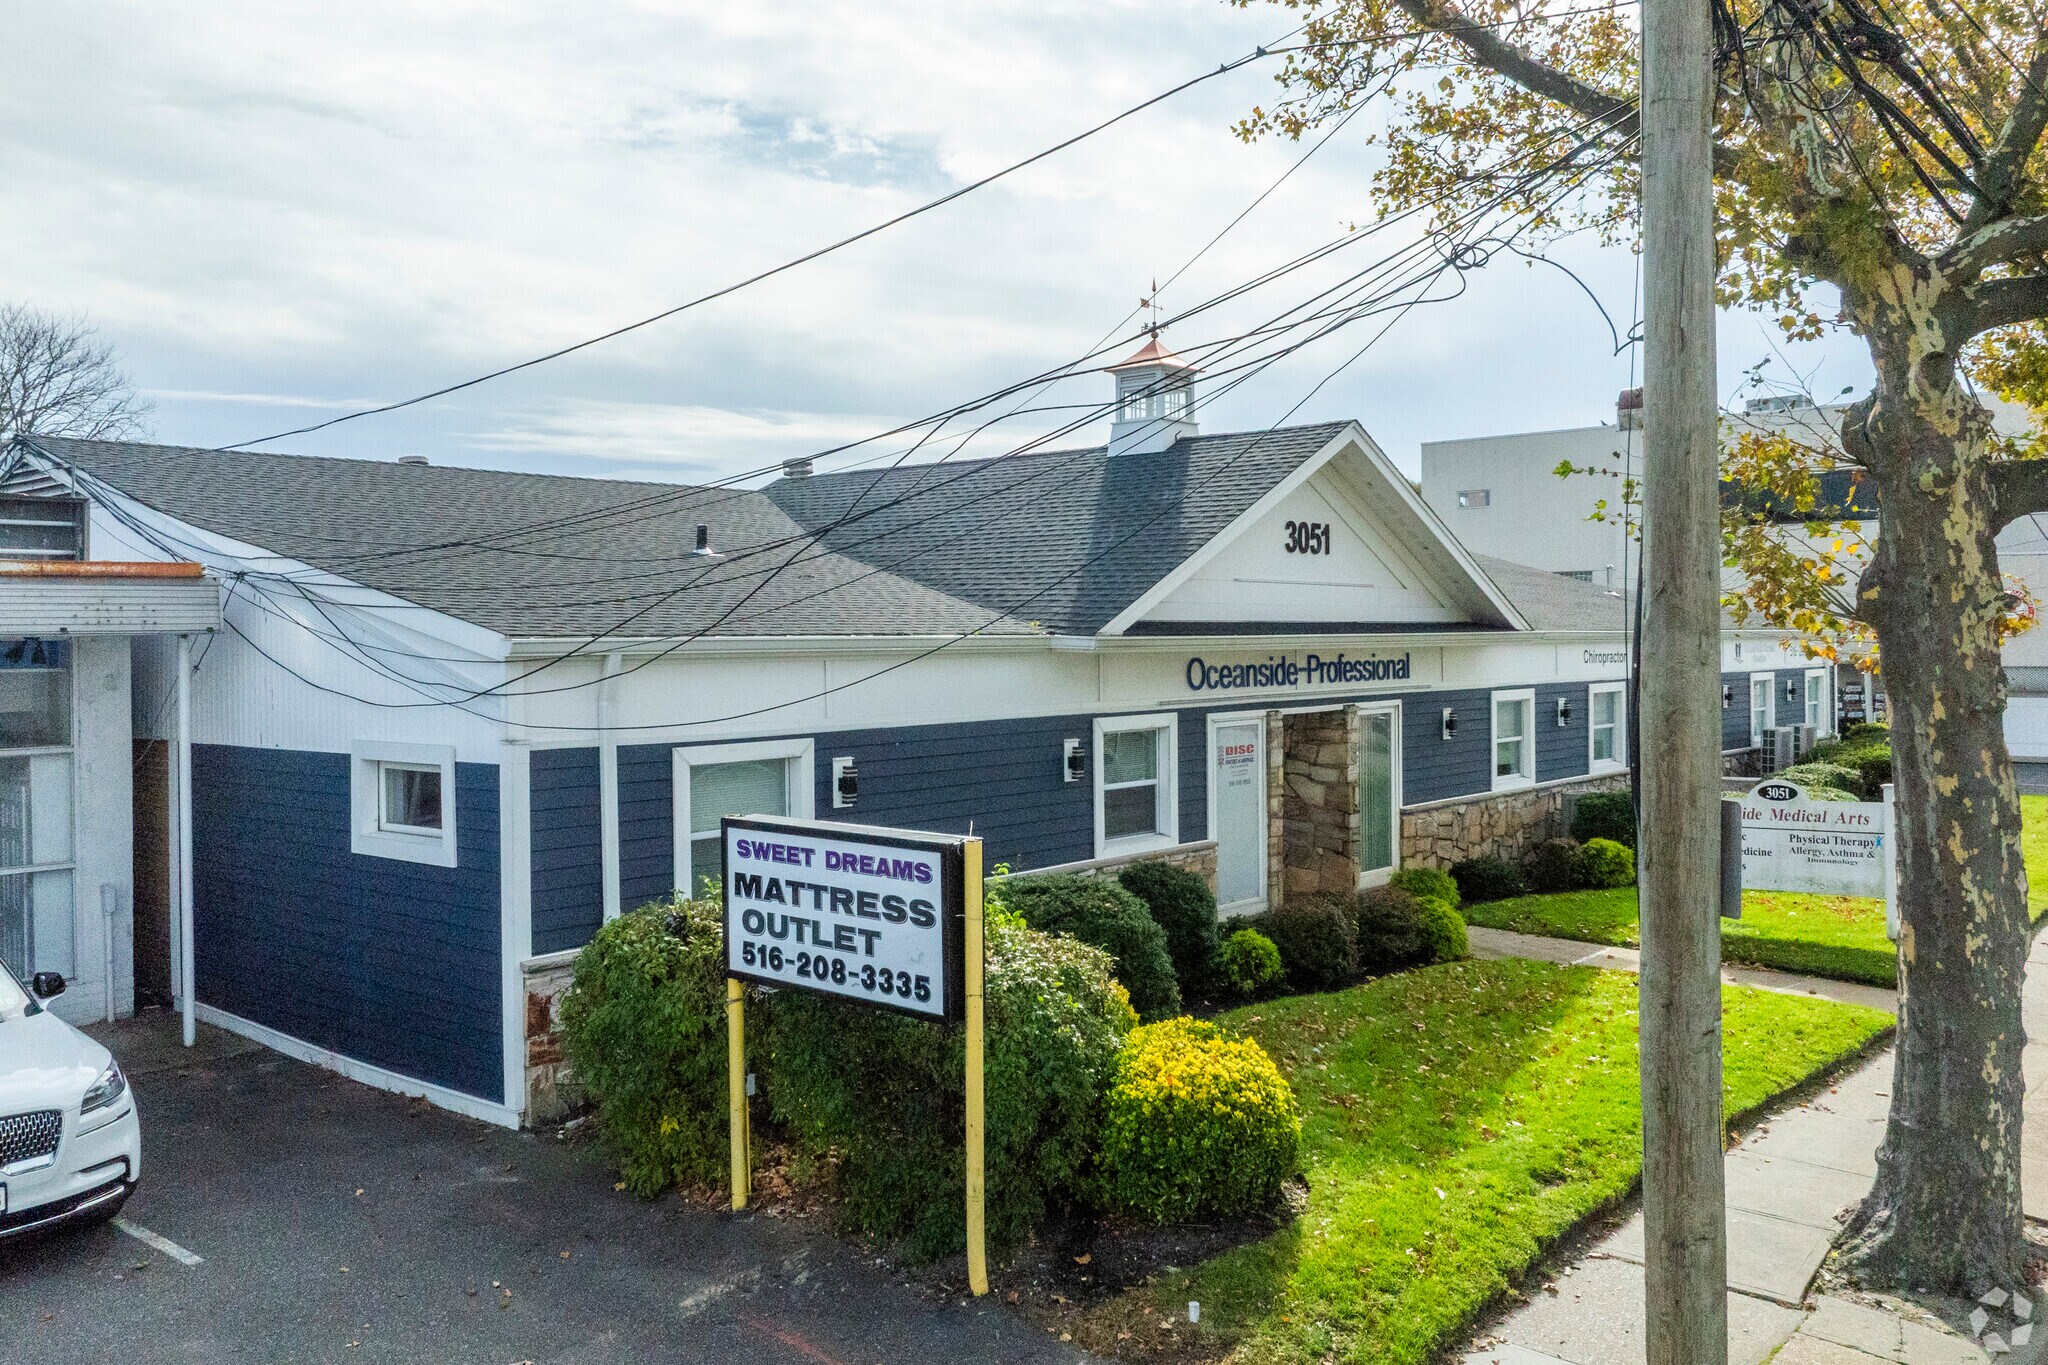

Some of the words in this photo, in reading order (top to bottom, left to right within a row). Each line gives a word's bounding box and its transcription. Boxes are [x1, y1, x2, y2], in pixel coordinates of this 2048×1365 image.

[1285, 520, 1331, 555] 3051
[1186, 652, 1411, 691] Oceanside-Professional
[1225, 744, 1254, 756] DISC
[1765, 787, 1790, 799] 3051
[1769, 808, 1828, 823] Medical
[1835, 812, 1870, 825] Arts
[1789, 833, 1830, 846] Physical
[1833, 836, 1876, 849] Therapy
[1789, 847, 1825, 858] Allergy,
[1827, 849, 1864, 858] Asthma
[1866, 850, 1876, 859] &
[736, 839, 815, 867] SWEET
[825, 850, 933, 884] DREAMS
[1807, 857, 1859, 866] Immunology
[734, 871, 937, 929] MATTRESS
[742, 908, 882, 958] OUTLET
[742, 940, 932, 1003] 516-208-3335
